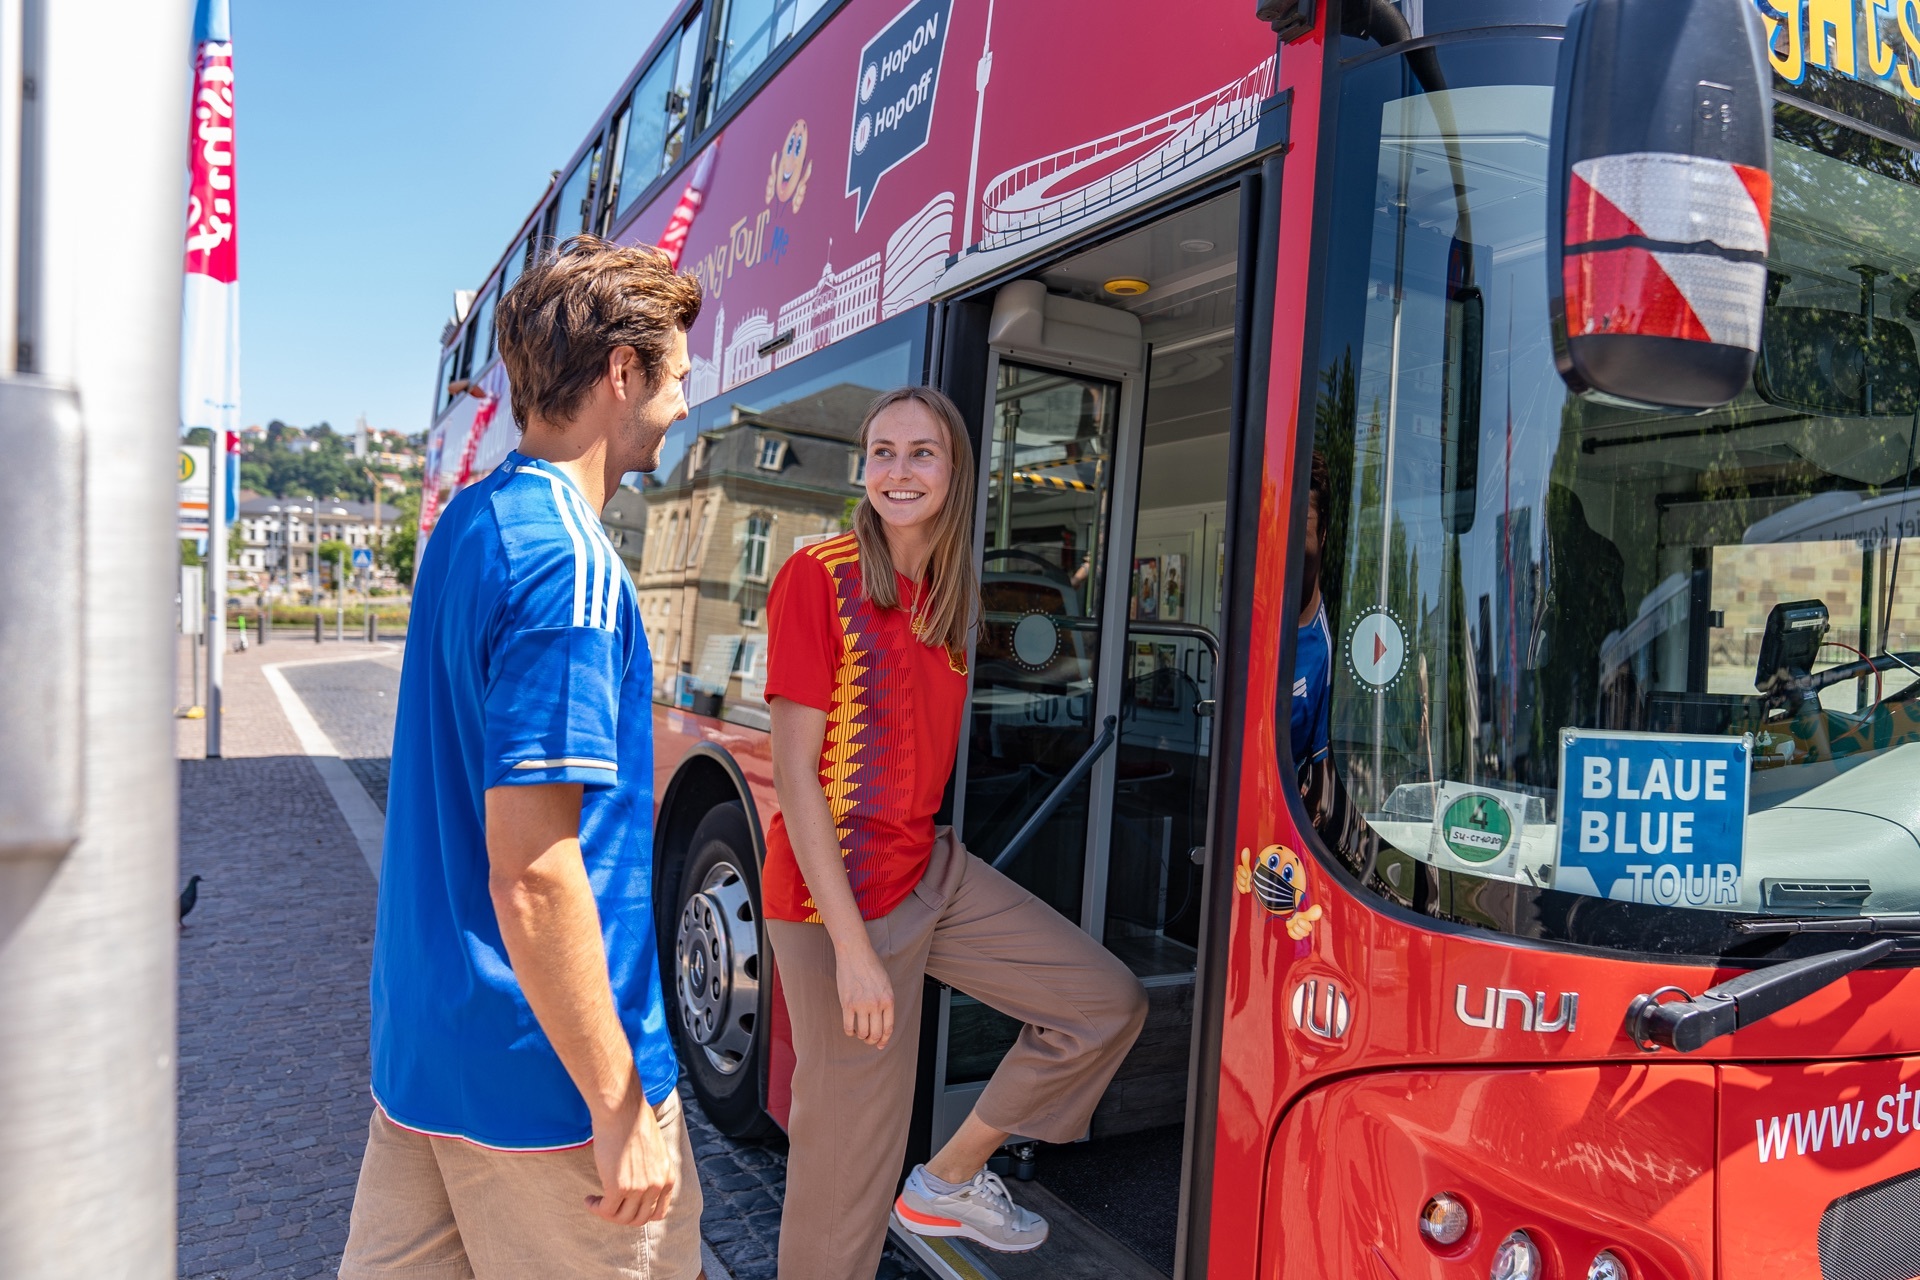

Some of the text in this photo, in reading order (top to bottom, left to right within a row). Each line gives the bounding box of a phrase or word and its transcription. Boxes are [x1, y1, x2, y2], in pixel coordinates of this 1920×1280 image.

[880, 11, 939, 82] HopON
[873, 67, 933, 138] HopOff
[1582, 756, 1728, 801] BLAUE
[1469, 800, 1488, 830] 4
[1579, 811, 1695, 854] BLUE
[1626, 863, 1738, 906] TOUR
